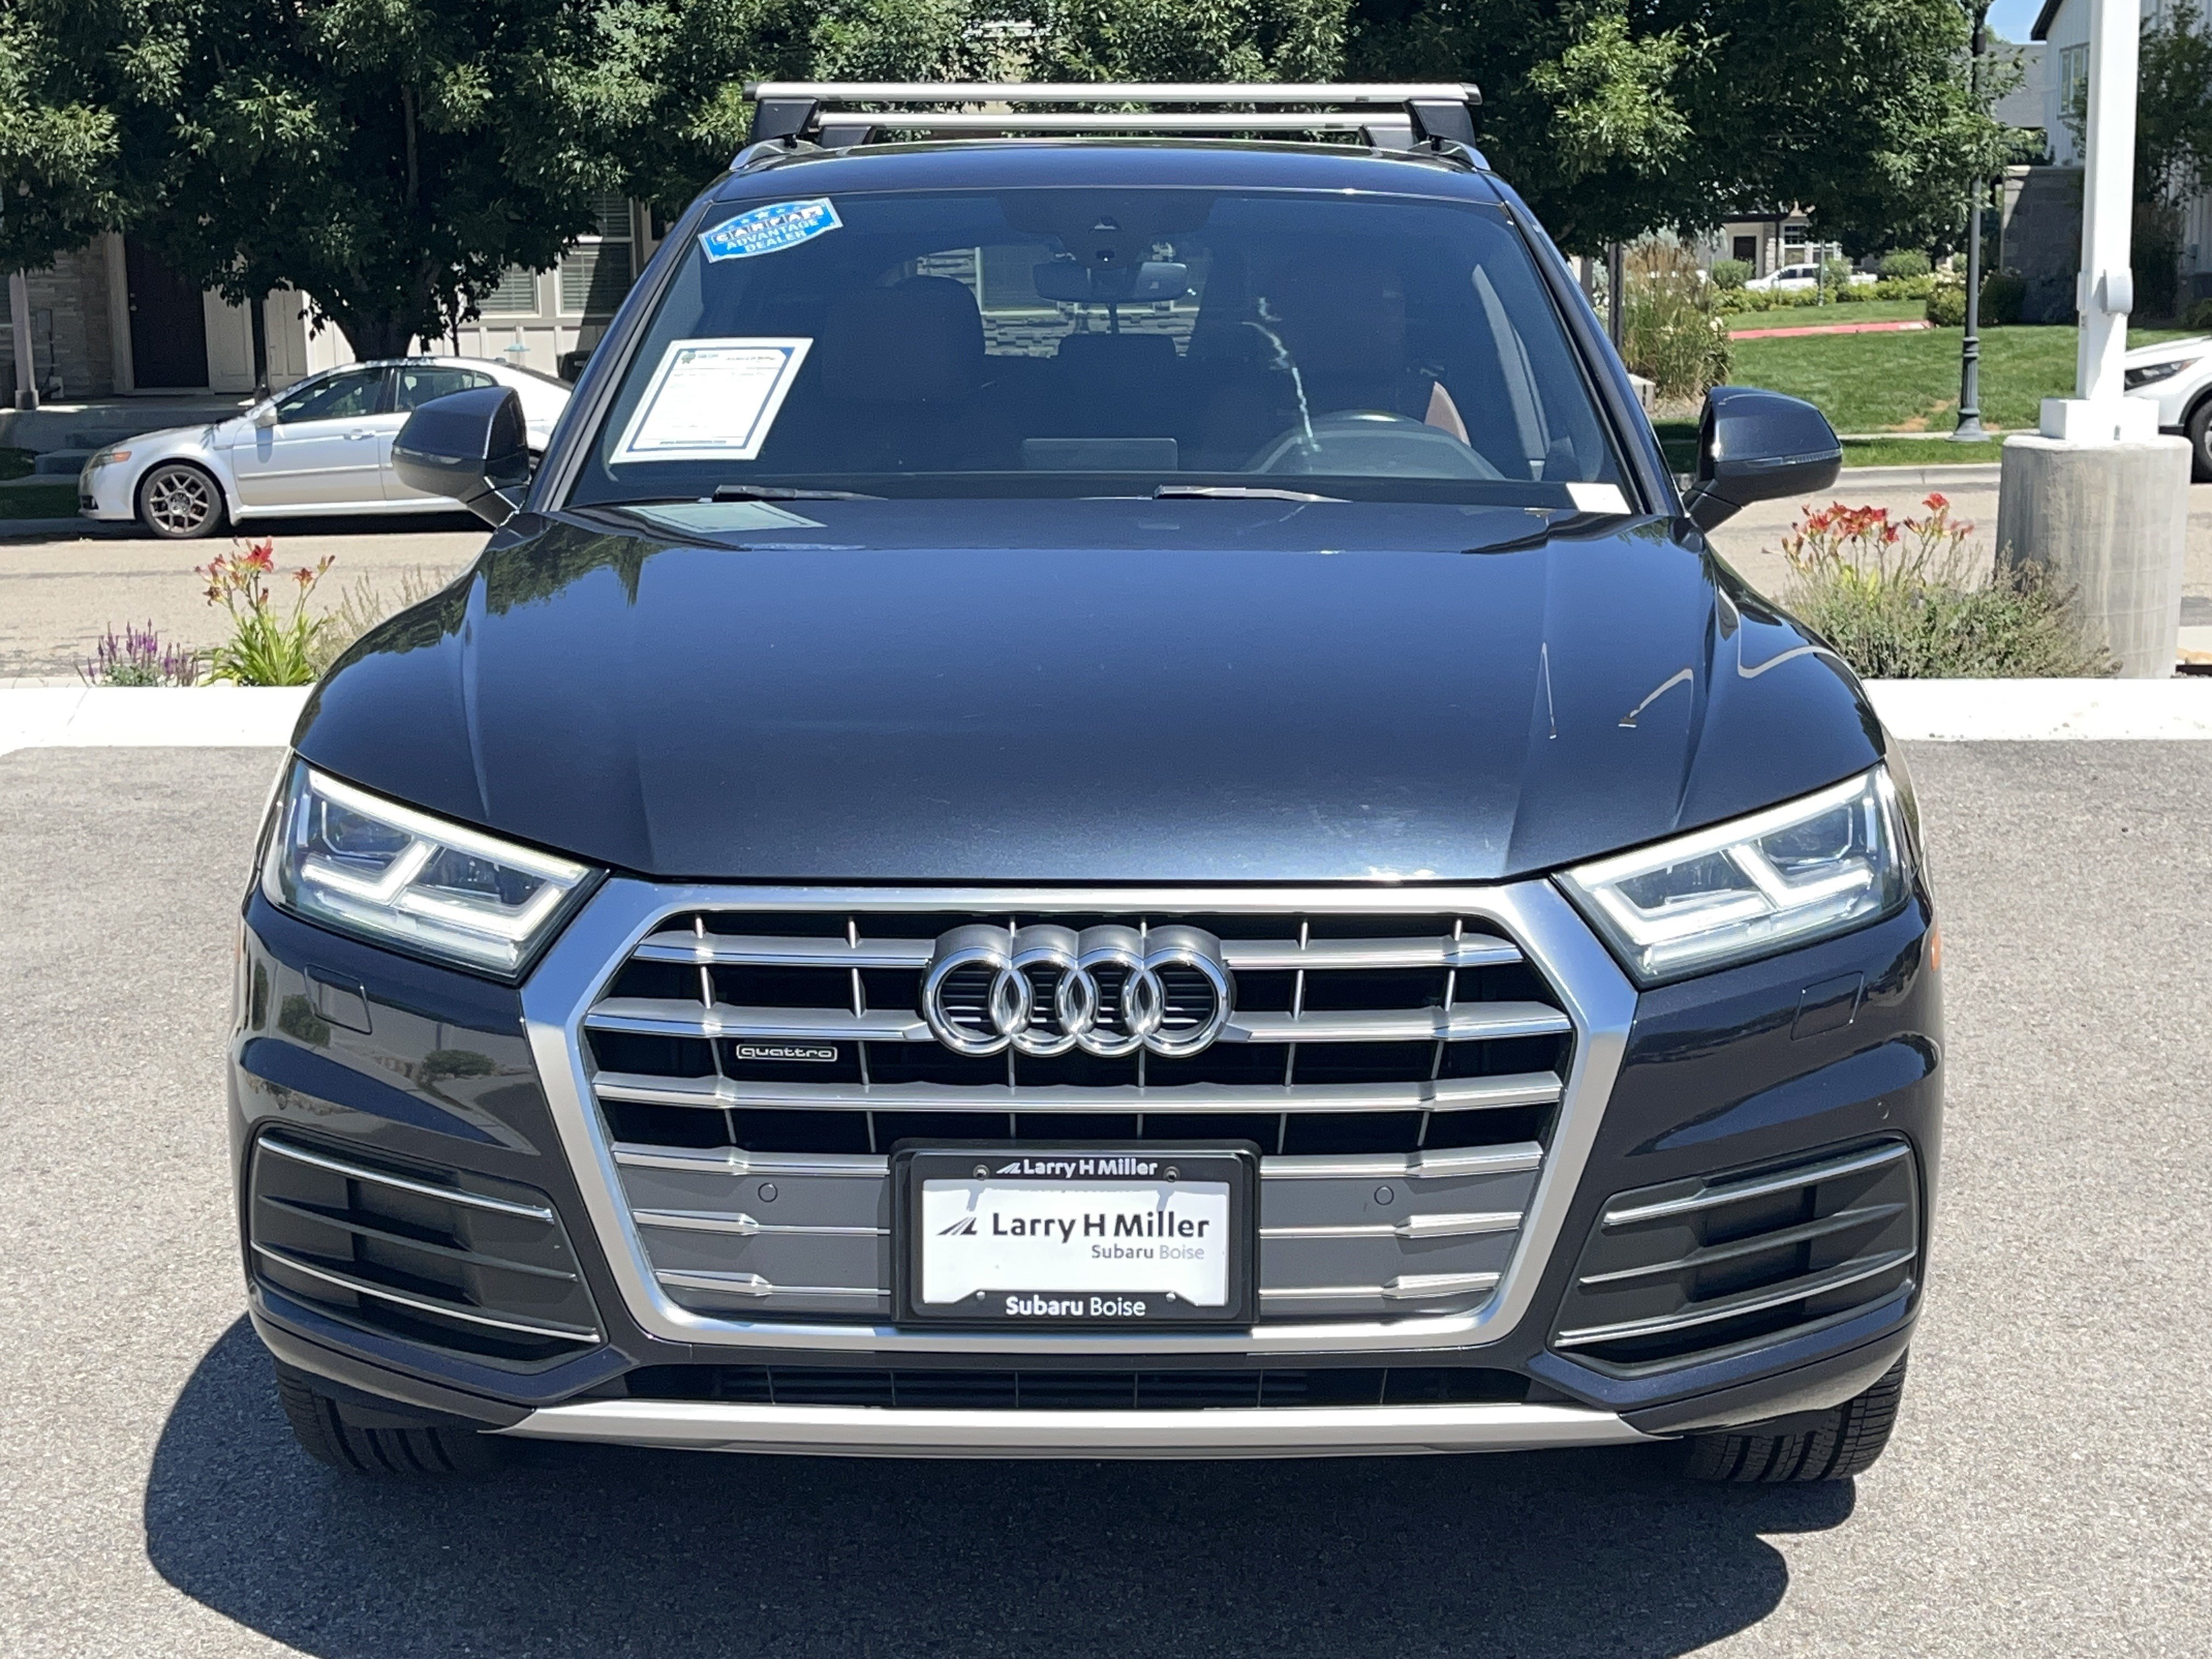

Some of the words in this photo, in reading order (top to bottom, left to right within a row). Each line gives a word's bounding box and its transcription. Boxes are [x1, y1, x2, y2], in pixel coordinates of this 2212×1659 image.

[726, 219, 819, 250] ADVANTAGE
[745, 230, 807, 252] DEALER
[741, 1047, 833, 1058] quattro
[1023, 1159, 1076, 1178] Larry
[1080, 1160, 1095, 1175] H
[1098, 1158, 1158, 1176] Miller
[992, 1213, 1075, 1243] Larry
[1084, 1214, 1105, 1236] H
[1114, 1211, 1210, 1237] Miller
[1092, 1245, 1154, 1259] Subaru
[1159, 1245, 1205, 1260] Boise
[1006, 1294, 1084, 1316] Subaru
[1091, 1296, 1147, 1316] Boise
